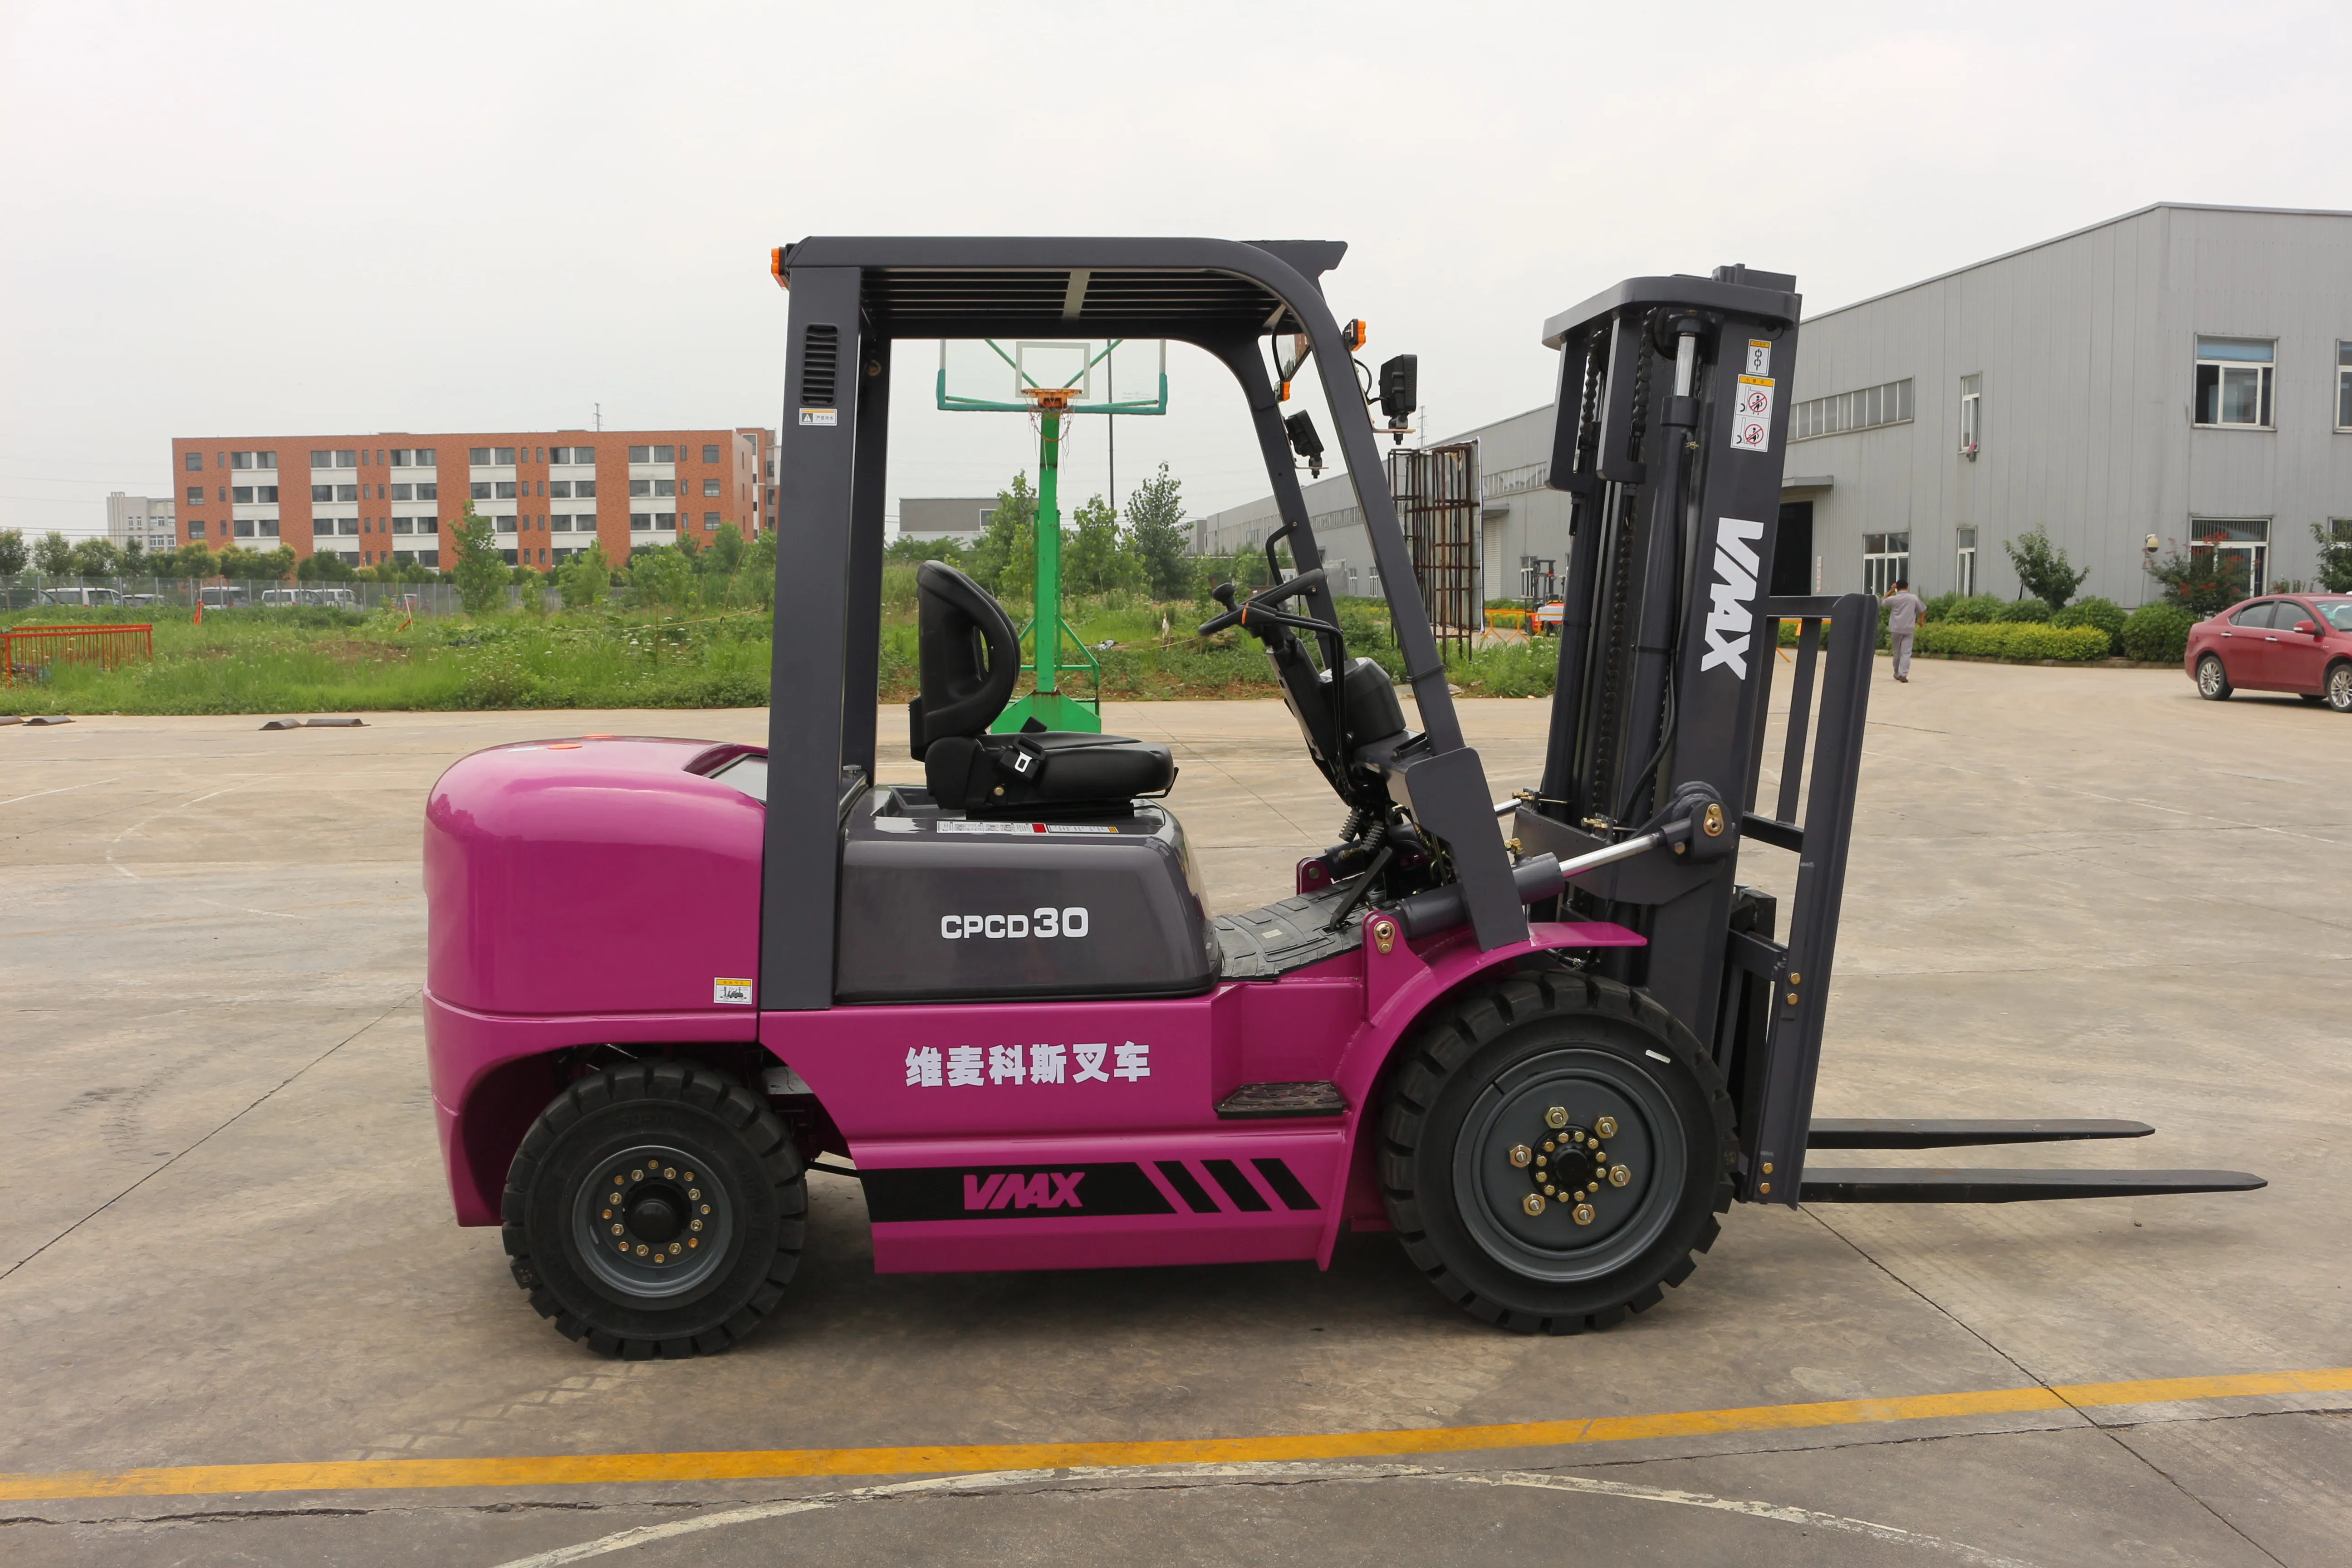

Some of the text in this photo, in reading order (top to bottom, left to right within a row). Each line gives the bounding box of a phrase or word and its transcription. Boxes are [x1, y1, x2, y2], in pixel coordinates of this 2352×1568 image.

[1701, 517, 1764, 680] VMAX
[905, 1041, 1150, 1087] 维麦科斯叉车
[963, 1172, 1085, 1210] VMAX
